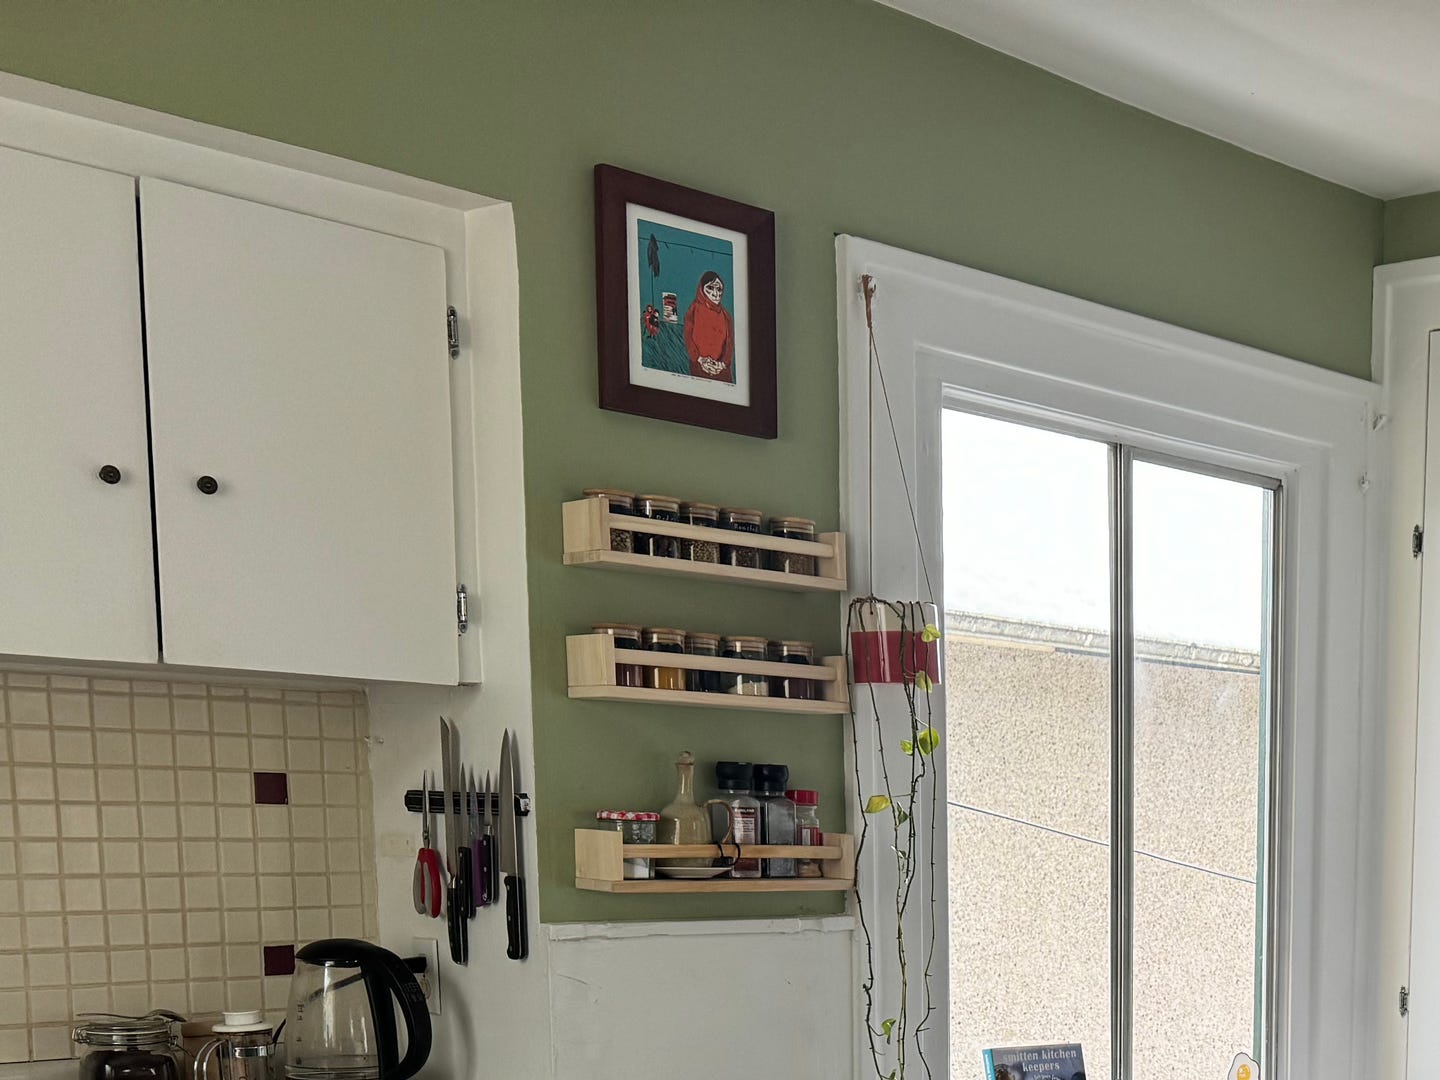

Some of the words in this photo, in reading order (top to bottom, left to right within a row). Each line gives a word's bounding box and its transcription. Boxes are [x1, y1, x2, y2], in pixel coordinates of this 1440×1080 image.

[1002, 1050, 1039, 1063] smitten
[1041, 1048, 1077, 1061] kitchen
[1022, 1061, 1060, 1073] keepers
